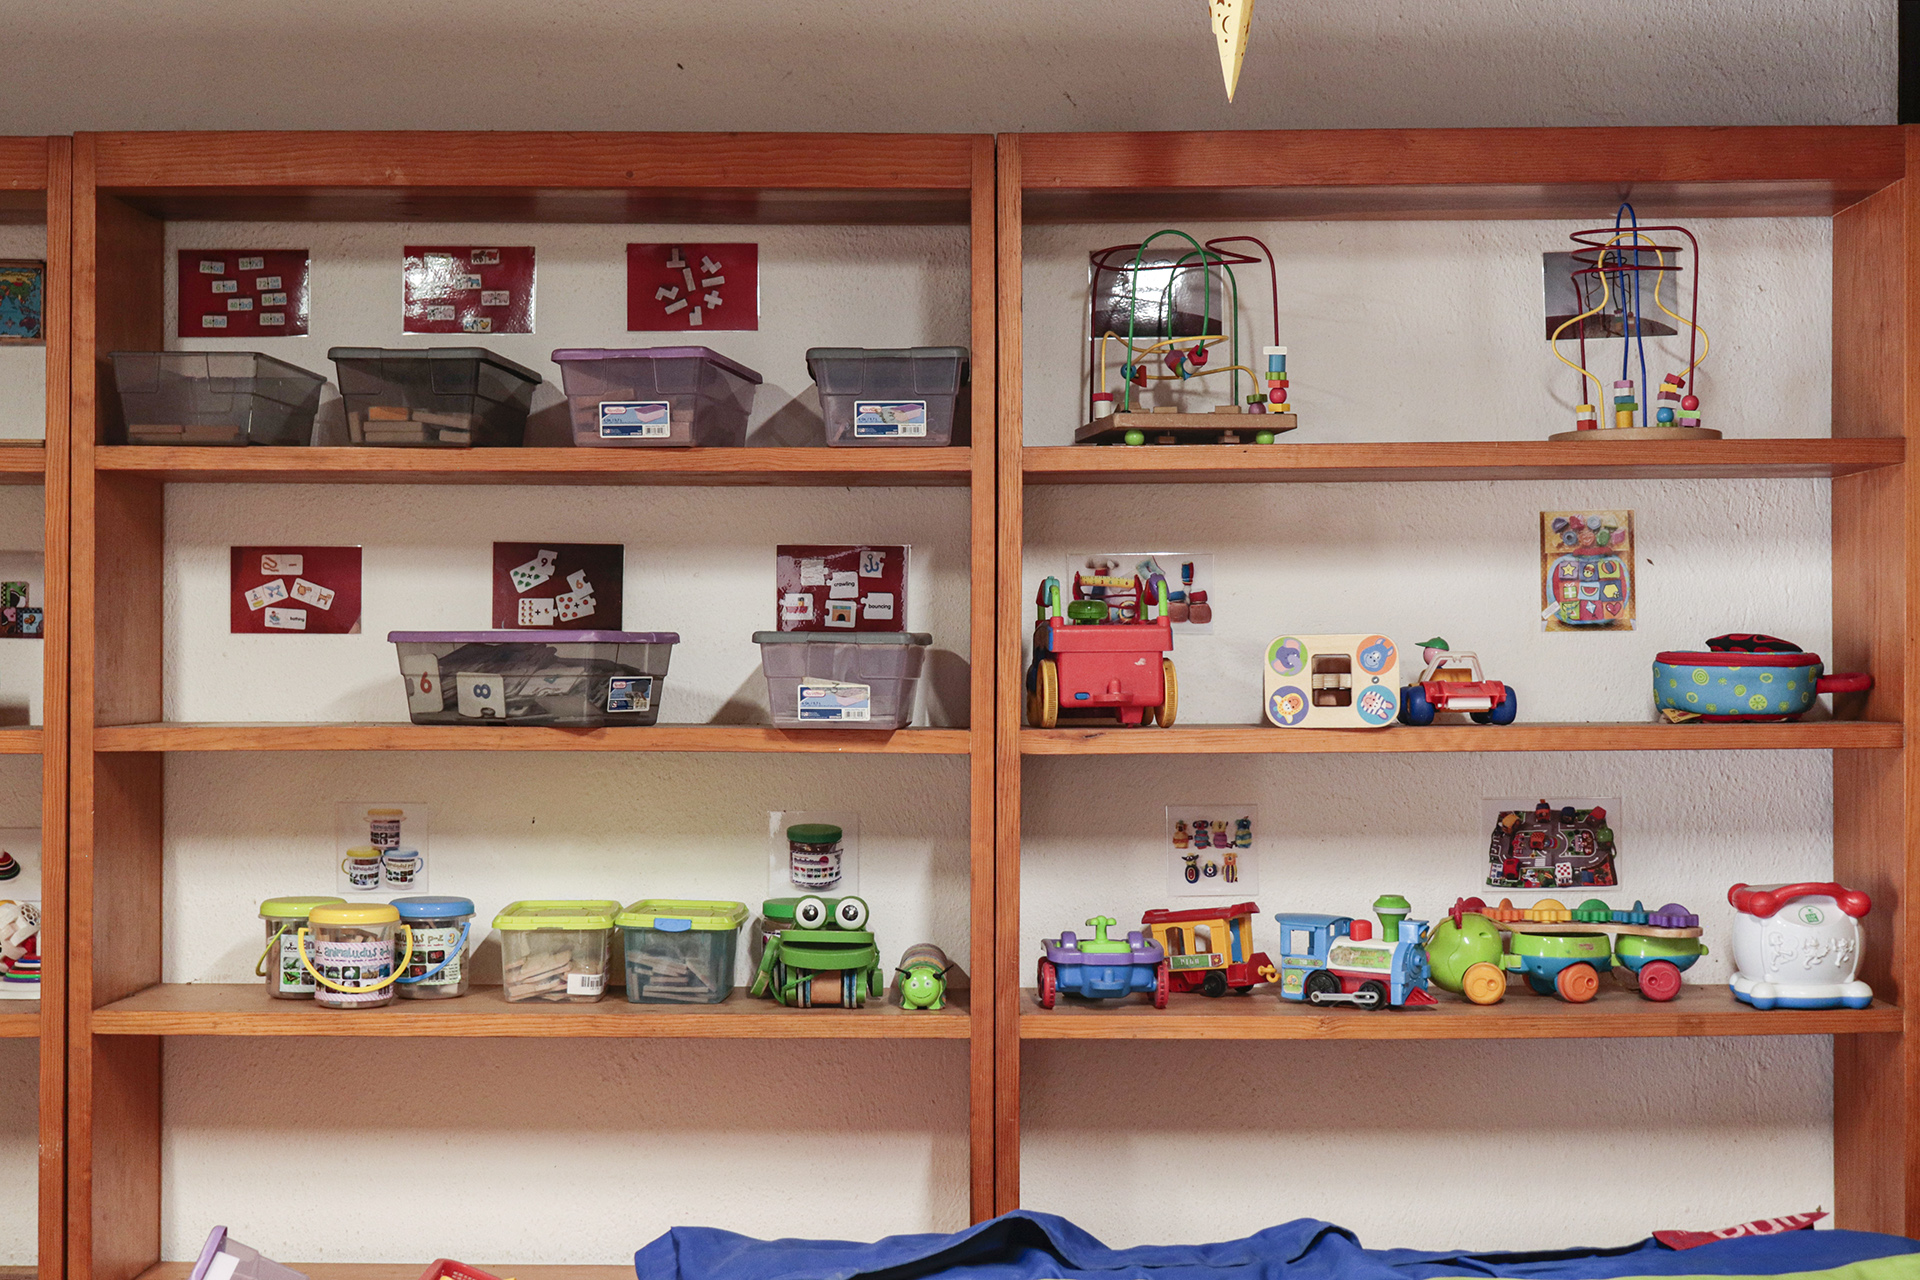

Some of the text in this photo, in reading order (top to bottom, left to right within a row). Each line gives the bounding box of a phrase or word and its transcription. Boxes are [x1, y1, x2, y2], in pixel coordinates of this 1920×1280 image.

[541, 558, 548, 567] 9
[576, 579, 583, 589] 6
[420, 671, 432, 694] 6
[473, 684, 491, 699] 8
[447, 932, 455, 944] 3
